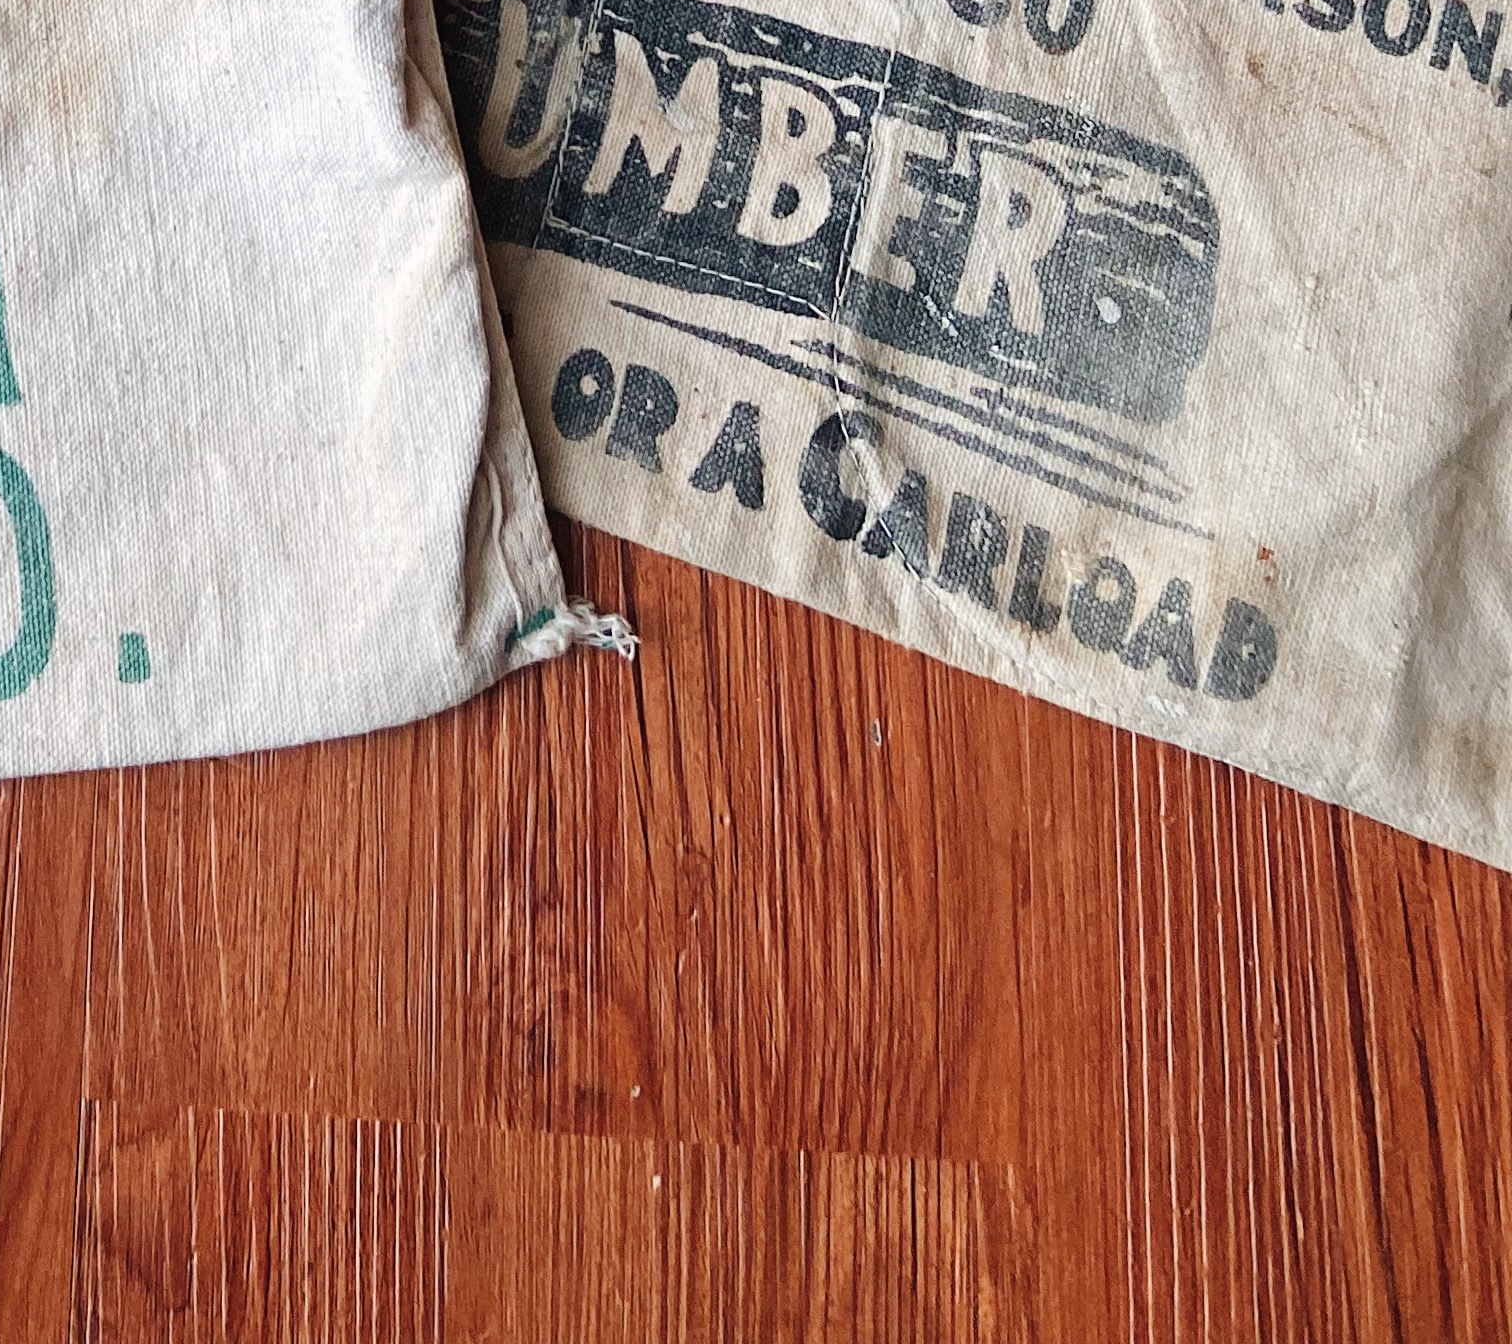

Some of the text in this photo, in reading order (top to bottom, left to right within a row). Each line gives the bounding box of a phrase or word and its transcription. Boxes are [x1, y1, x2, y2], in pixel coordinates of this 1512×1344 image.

[550, 347, 1279, 703] OR A CARLOAD
